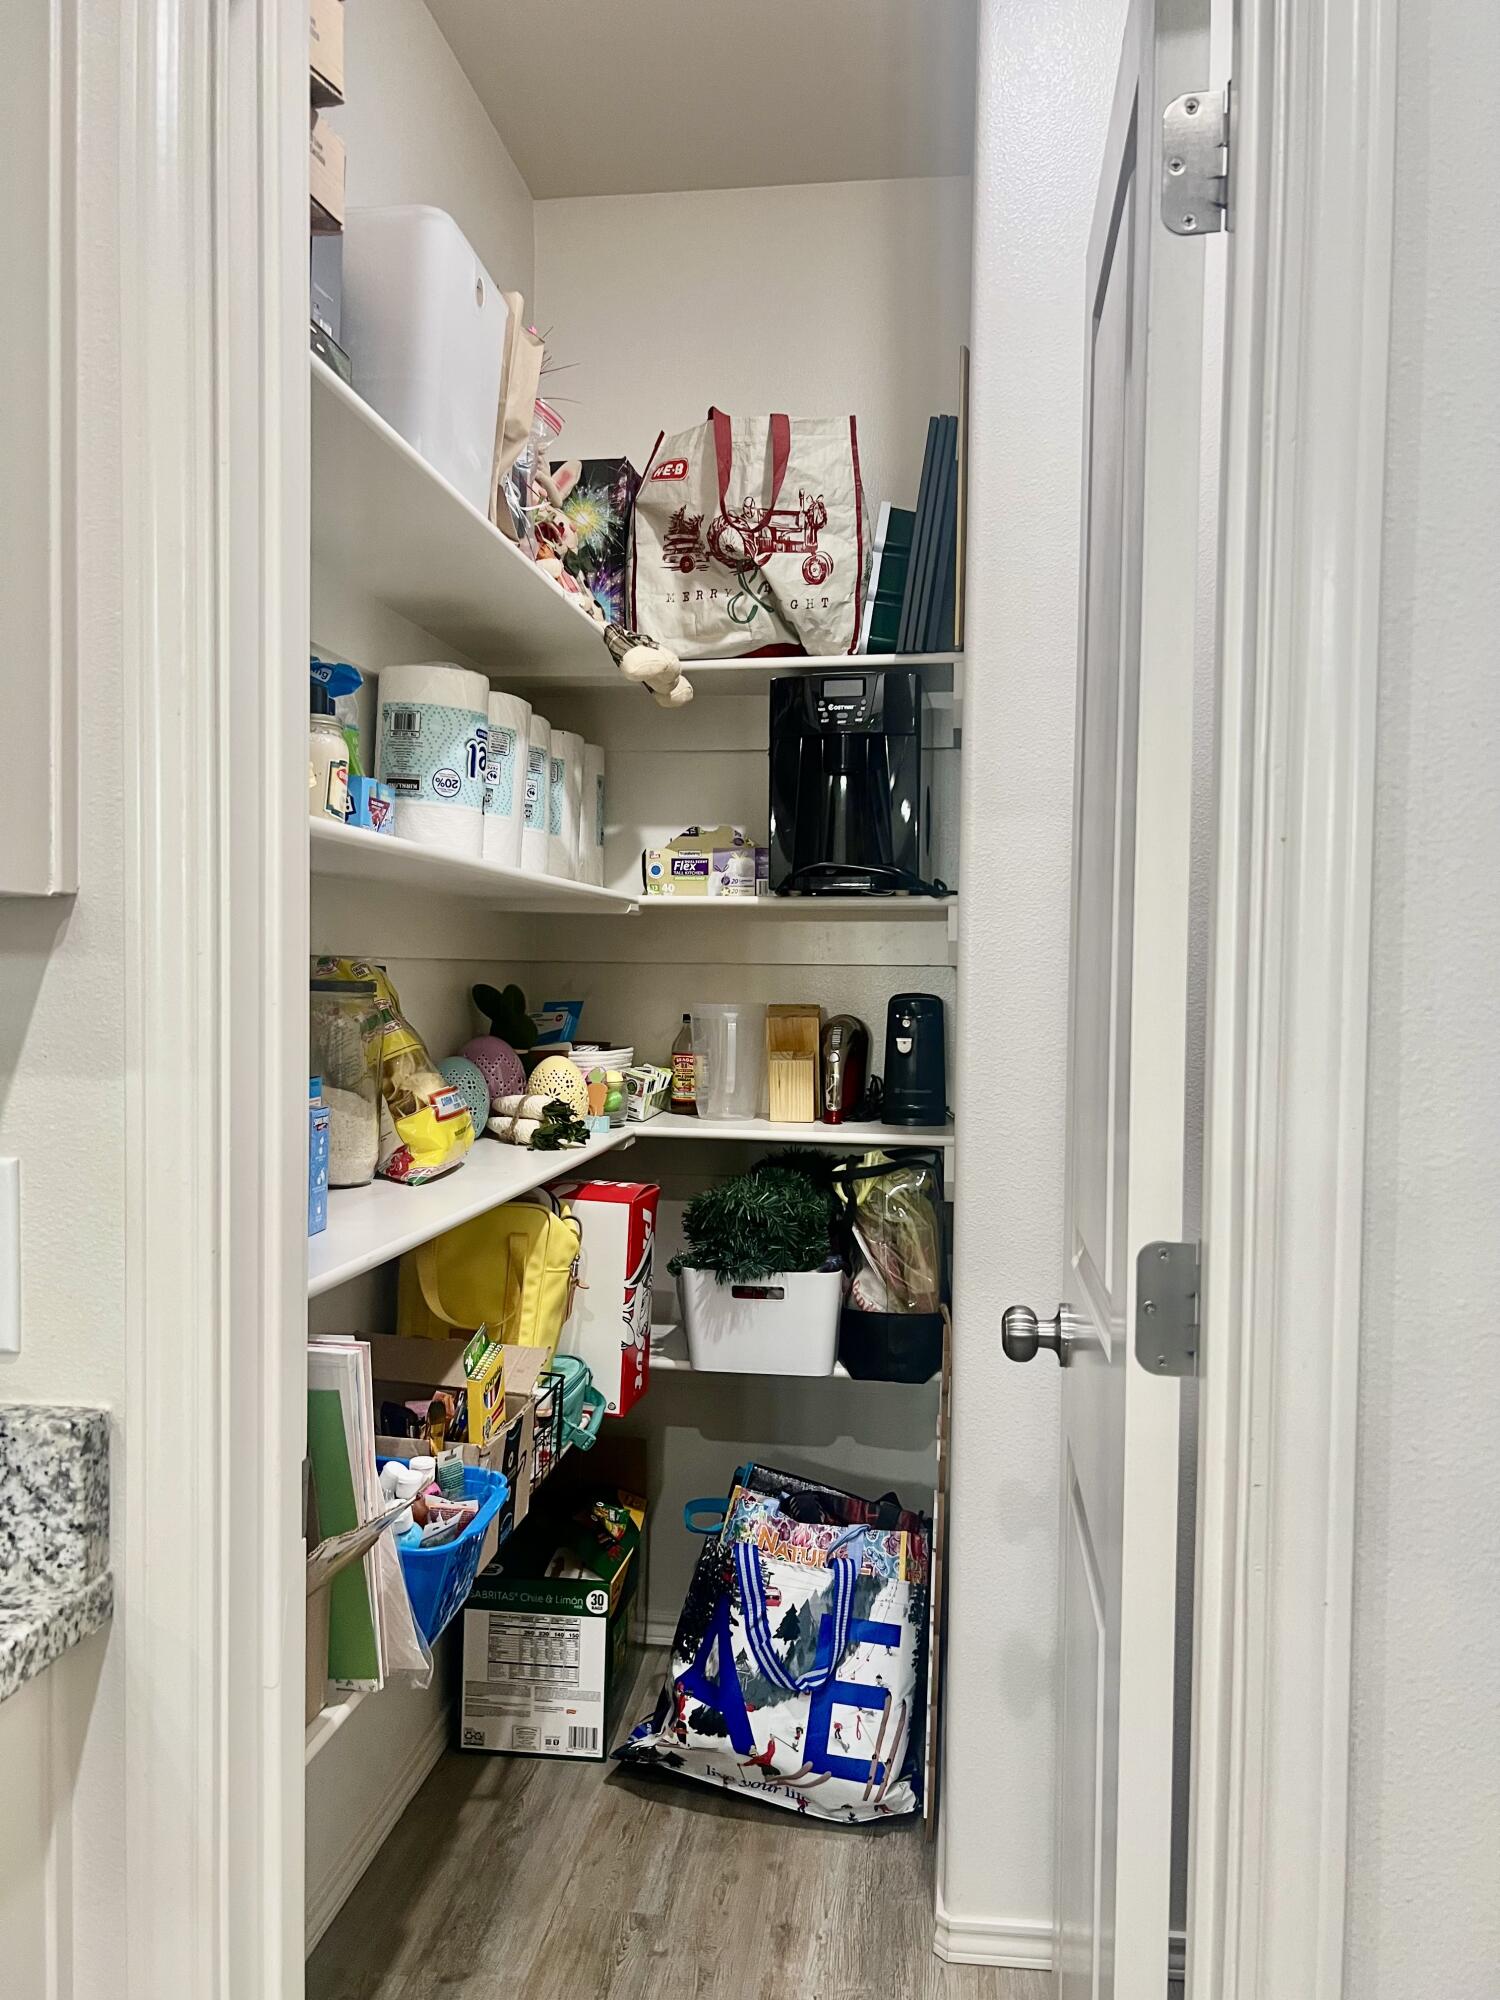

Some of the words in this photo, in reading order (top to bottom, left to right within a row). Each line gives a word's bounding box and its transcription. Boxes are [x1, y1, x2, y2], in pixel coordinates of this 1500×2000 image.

[666, 588, 732, 603] MERRY
[435, 777, 459, 789] 20%
[673, 860, 696, 871] Flex
[520, 1592, 544, 1603] Chile
[545, 1594, 553, 1604] &
[555, 1595, 583, 1607] Limón
[590, 1593, 605, 1606] 30
[738, 1779, 782, 1794] your
